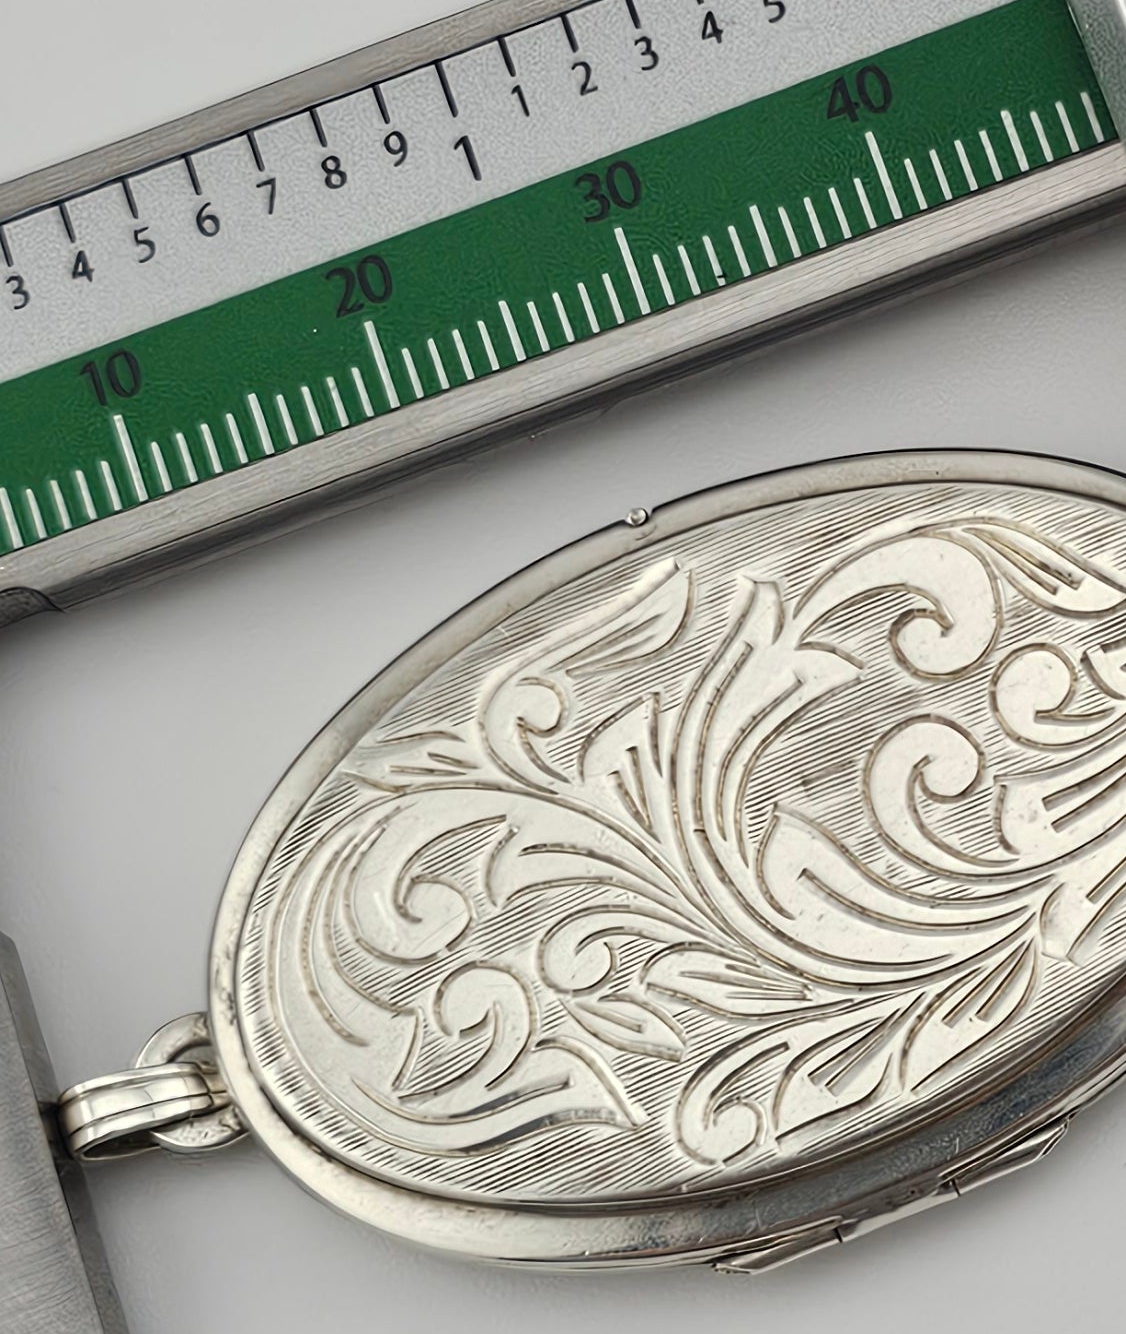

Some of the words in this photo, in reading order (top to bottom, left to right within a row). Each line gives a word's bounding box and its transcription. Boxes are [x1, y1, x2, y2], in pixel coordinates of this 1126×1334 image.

[5, 275, 30, 310] 3
[71, 249, 95, 283] 4
[132, 226, 156, 264] 5
[195, 201, 221, 238] 6
[255, 177, 277, 215] 7
[320, 154, 348, 190] 8
[383, 130, 408, 167] 9
[453, 135, 483, 182] 1
[511, 84, 530, 118] 1
[571, 60, 598, 96] 2
[633, 35, 660, 72] 3
[701, 10, 724, 44] 4
[79, 348, 142, 407] 10
[324, 254, 394, 319] 20
[574, 160, 642, 224] 30
[825, 63, 893, 124] 40
